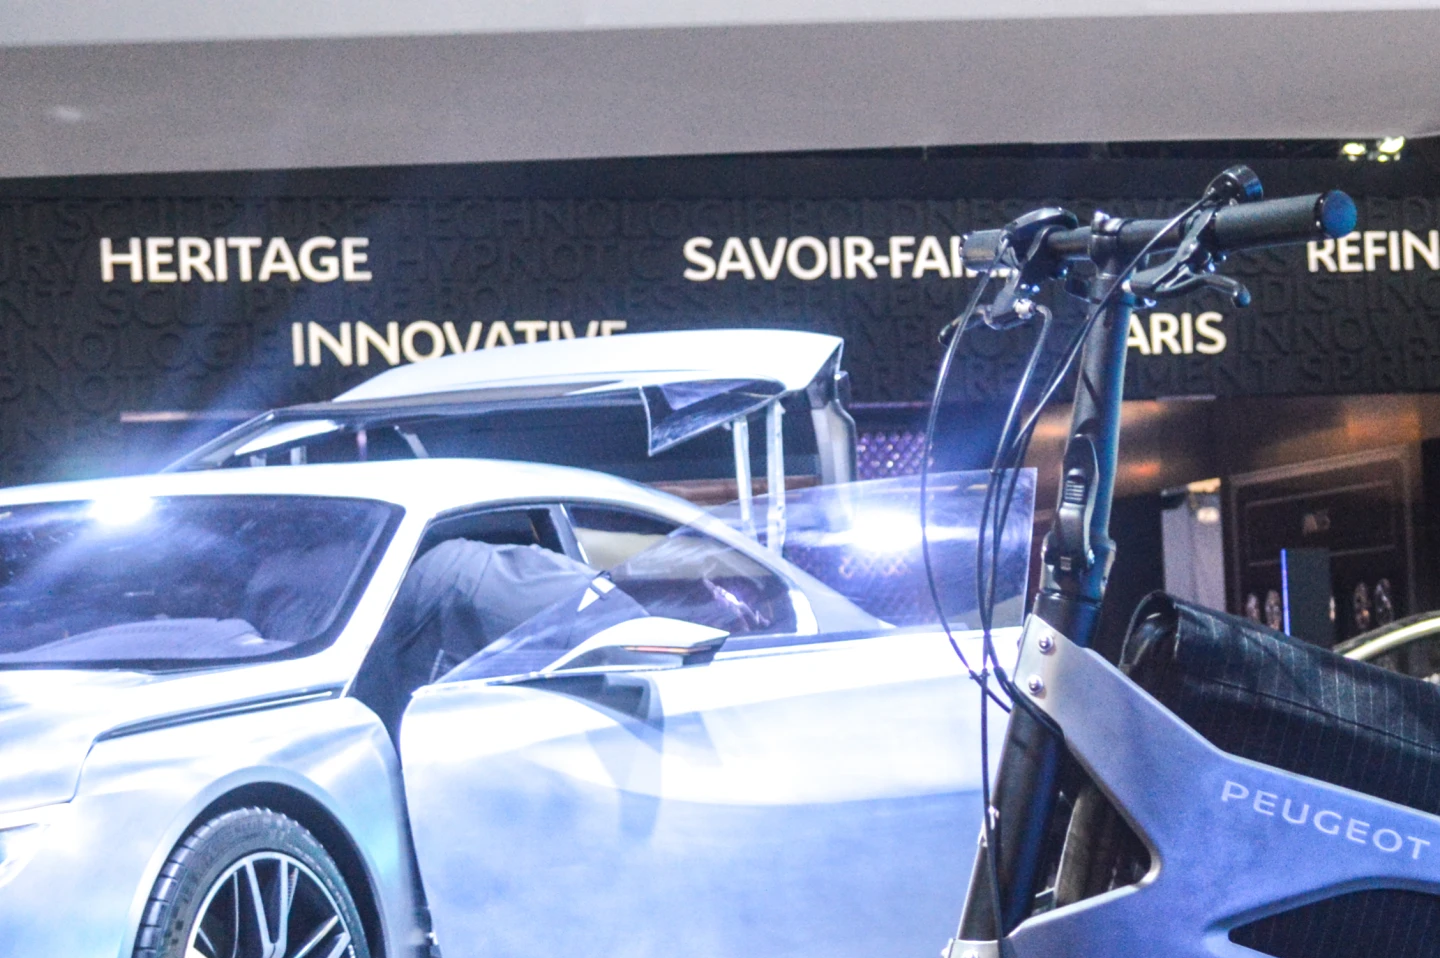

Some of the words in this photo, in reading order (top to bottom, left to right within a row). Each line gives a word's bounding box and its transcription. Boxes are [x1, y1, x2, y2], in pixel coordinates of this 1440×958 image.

[100, 236, 373, 283] HERITAGE
[683, 235, 1010, 281] SAVOIR-FAI
[1127, 311, 1227, 355] ARIS
[1220, 780, 1430, 860] PEUGEOT
